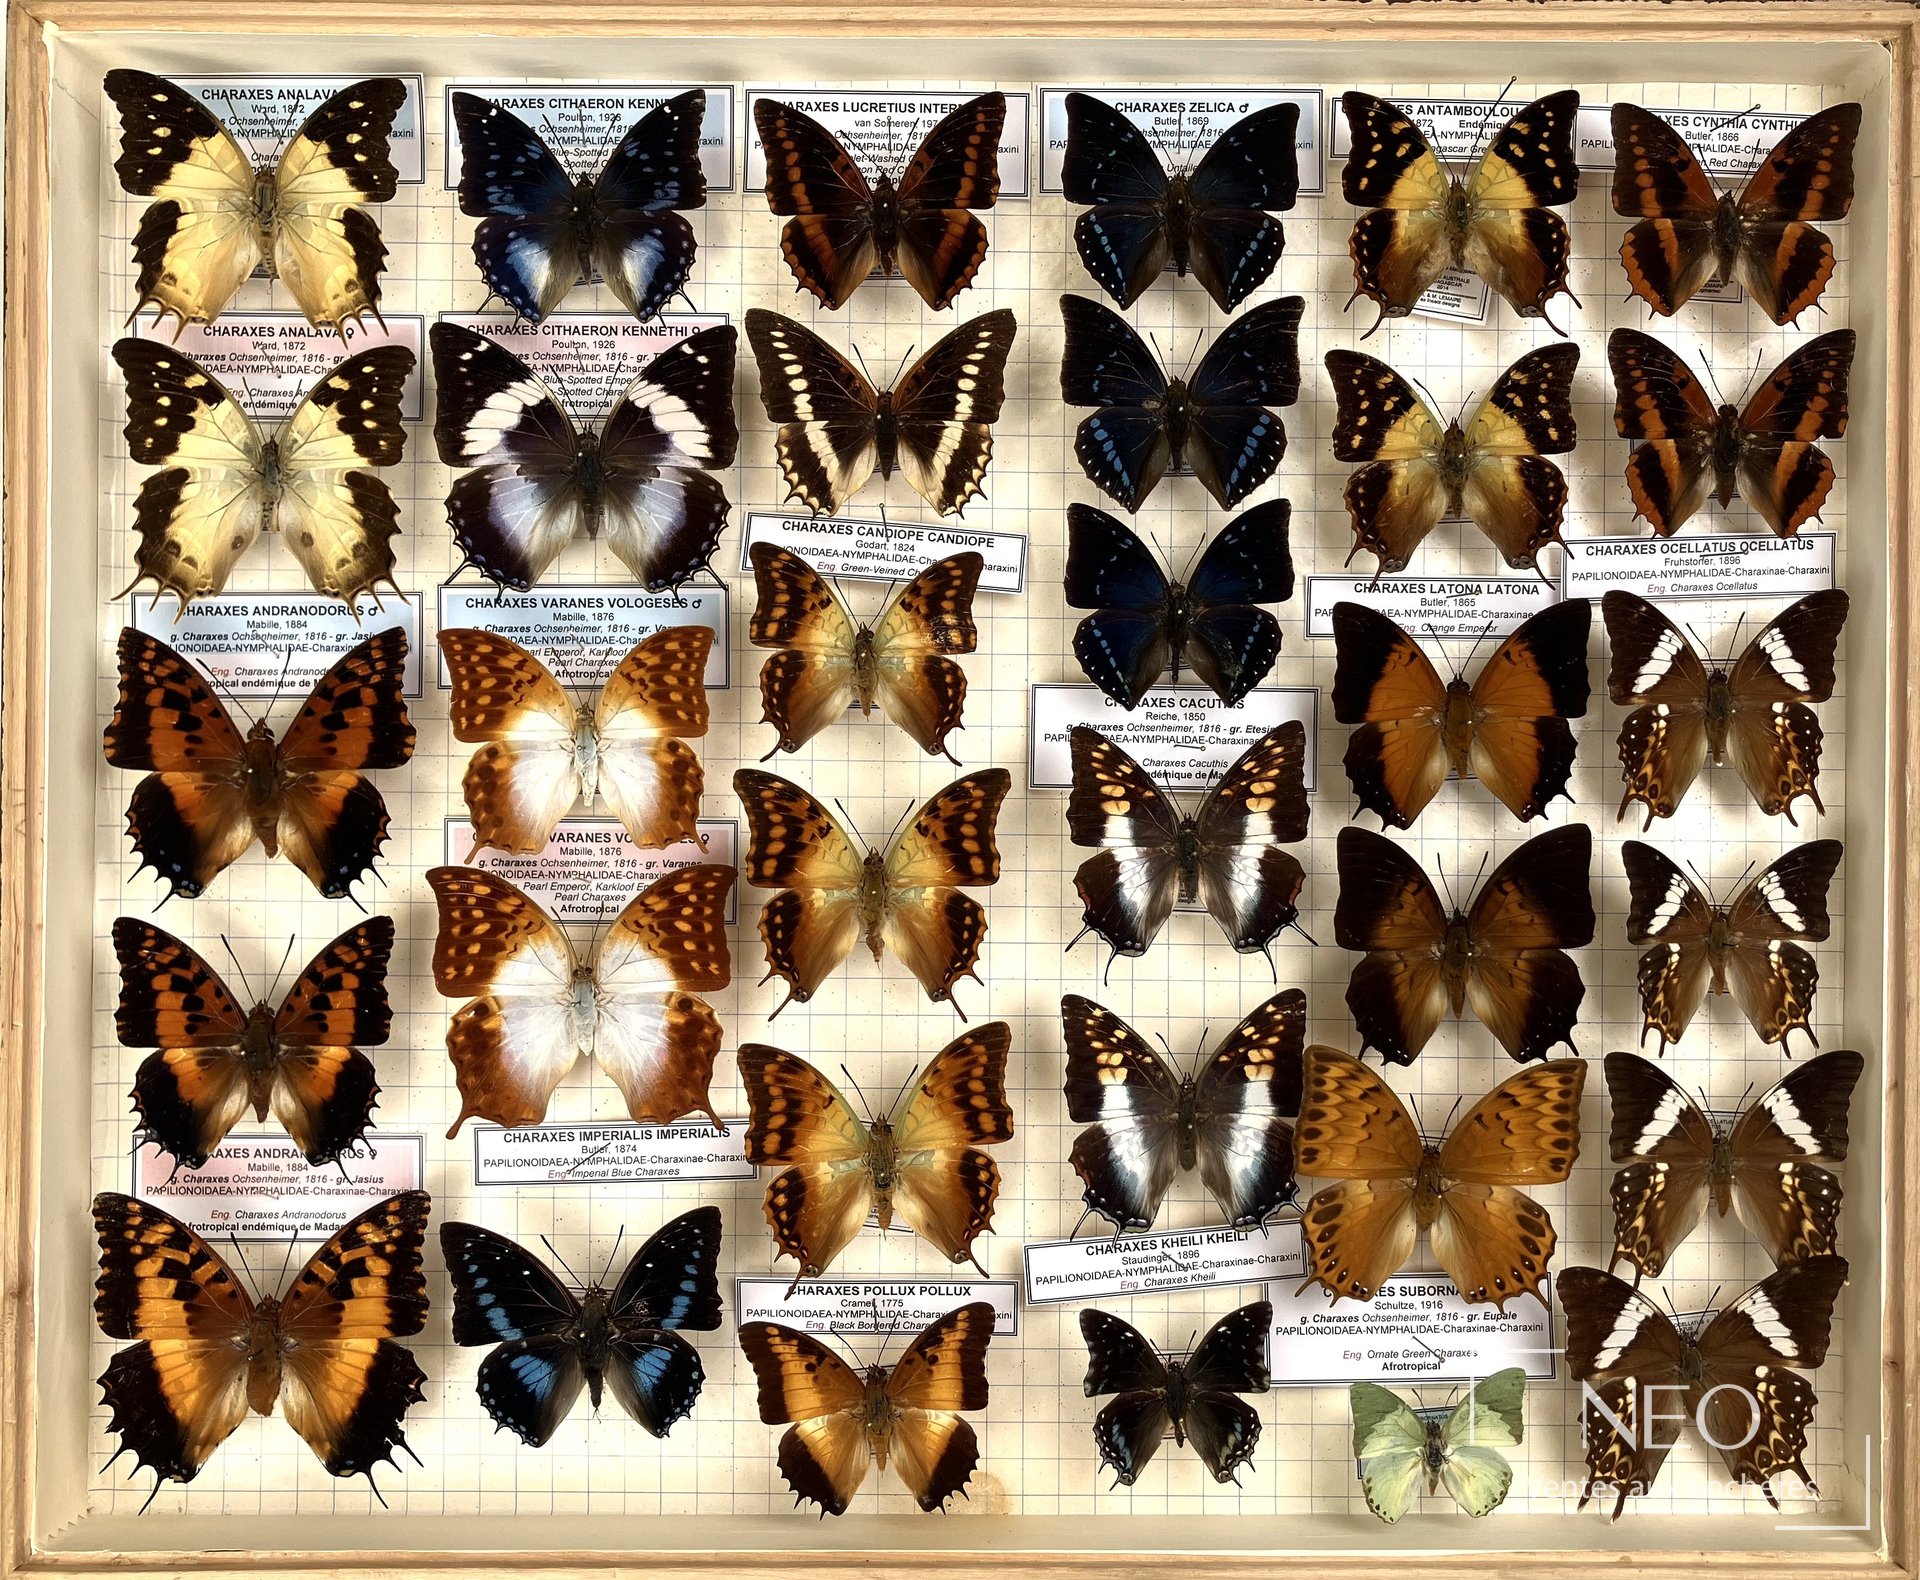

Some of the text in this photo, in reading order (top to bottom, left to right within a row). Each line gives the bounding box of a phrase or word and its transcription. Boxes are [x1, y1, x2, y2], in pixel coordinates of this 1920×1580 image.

[202, 89, 274, 100] CHARAXES
[549, 98, 624, 109] CITHAERON
[843, 102, 916, 113] LUCRETIUS
[1115, 102, 1235, 112] CHARAXES ZELICA
[1187, 117, 1210, 126] 1869
[1693, 116, 1748, 129] CYNTHIA
[1686, 131, 1739, 142] Butler, 1866
[1709, 158, 1728, 168] Red
[204, 326, 275, 336] CHARAXES
[542, 326, 688, 336] CITHAERON KENNETHI
[283, 342, 306, 350] 1872
[593, 340, 616, 348] 1926
[302, 354, 324, 362] 1816
[606, 352, 628, 361] 1816
[782, 520, 994, 548] CHARAXES CANDIOPE CANDIOPE
[856, 540, 915, 552] Godart, 1824
[1586, 540, 1814, 556] CHARAXES OCELLATUS OCELLATUS
[1719, 556, 1740, 566] 1896
[816, 561, 838, 572] Eng.
[841, 563, 906, 577] Green-Veined
[1430, 584, 1482, 594] LATONA
[1486, 584, 1540, 595] LATONA
[1647, 582, 1758, 594] Eng. Charaxes Ocellatus
[540, 598, 604, 608] VARANES
[1420, 598, 1476, 608] Butler, 1865
[552, 612, 614, 622] Mabille, 1876
[246, 620, 308, 630] Mabille, 1884
[534, 624, 602, 634] Ochsenheimer,
[608, 624, 630, 632] 1816
[182, 632, 228, 640] Charaxes
[305, 632, 327, 640] 1816
[234, 667, 278, 676] Charaxes
[298, 678, 310, 688] de
[1146, 712, 1206, 722] Reiche, 1850
[1126, 722, 1221, 734] Ochsenheimer, 1816
[1142, 758, 1228, 768] Charaxes Cacuthis
[1195, 771, 1207, 779] de
[560, 846, 622, 856] Mabille, 1876
[491, 858, 637, 868] Charaxes Ochsenheimer, 1816
[523, 882, 548, 890] Pearl
[550, 882, 592, 892] Emperor,
[596, 882, 634, 892] Karkloof
[554, 892, 626, 902] Pearl Charaxes
[560, 904, 620, 915] Afrotropical
[504, 1128, 730, 1143] CHARAXES IMPERIALIS IMPERIALIS
[614, 1144, 637, 1154] 1874
[248, 1163, 308, 1173] Mabille, 1884
[572, 1166, 680, 1179] Imperial Blue Charaxes
[183, 1174, 384, 1184] Charaxes Ochsenheimer, 1816 Jasius
[211, 1210, 346, 1220] Eng. Charaxes Andranodorus
[242, 1222, 298, 1232] endémique
[300, 1222, 312, 1231] de
[1086, 1240, 1158, 1256] CHARAXES
[1162, 1236, 1204, 1250] KHEILI
[1178, 1250, 1200, 1260] 1896
[1120, 1272, 1216, 1290] Eng. Charaxes Kheili
[864, 1286, 972, 1296] POLLUX POLLUX
[881, 1299, 904, 1308] 1775
[1374, 1300, 1444, 1310] Schultze, 1916
[1312, 1310, 1518, 1324] Charaxes Ochsenheimer, 1816 gr. Eupale
[806, 1320, 826, 1330] Eng.
[830, 1320, 854, 1330] Black
[1343, 1350, 1364, 1360] Eng.
[1367, 1350, 1399, 1358] Ornate
[1402, 1349, 1431, 1358] Green
[1382, 1361, 1440, 1372] Afrotropical
